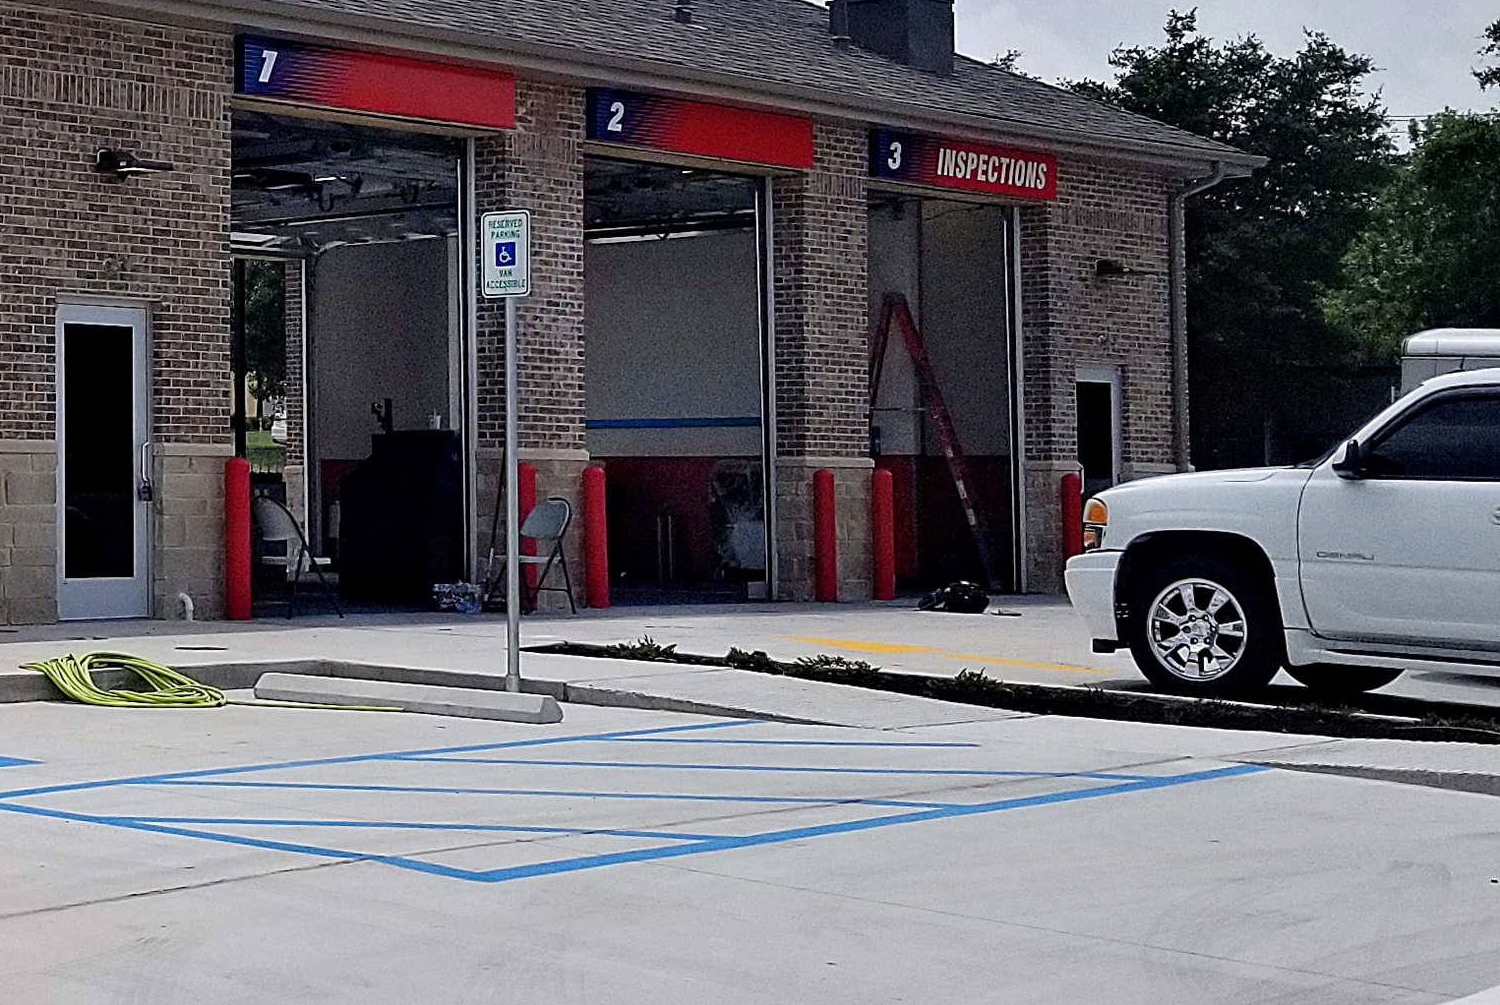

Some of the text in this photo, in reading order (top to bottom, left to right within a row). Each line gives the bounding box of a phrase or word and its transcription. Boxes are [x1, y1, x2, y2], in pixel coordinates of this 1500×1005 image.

[258, 49, 279, 83] 1
[607, 101, 625, 132] 2
[887, 141, 1048, 190] 3 INSPECTIONS
[488, 219, 523, 229] RESERVED
[491, 230, 520, 239] PARKING
[499, 269, 512, 277] VAN
[487, 279, 526, 289] ACCESSIBLE
